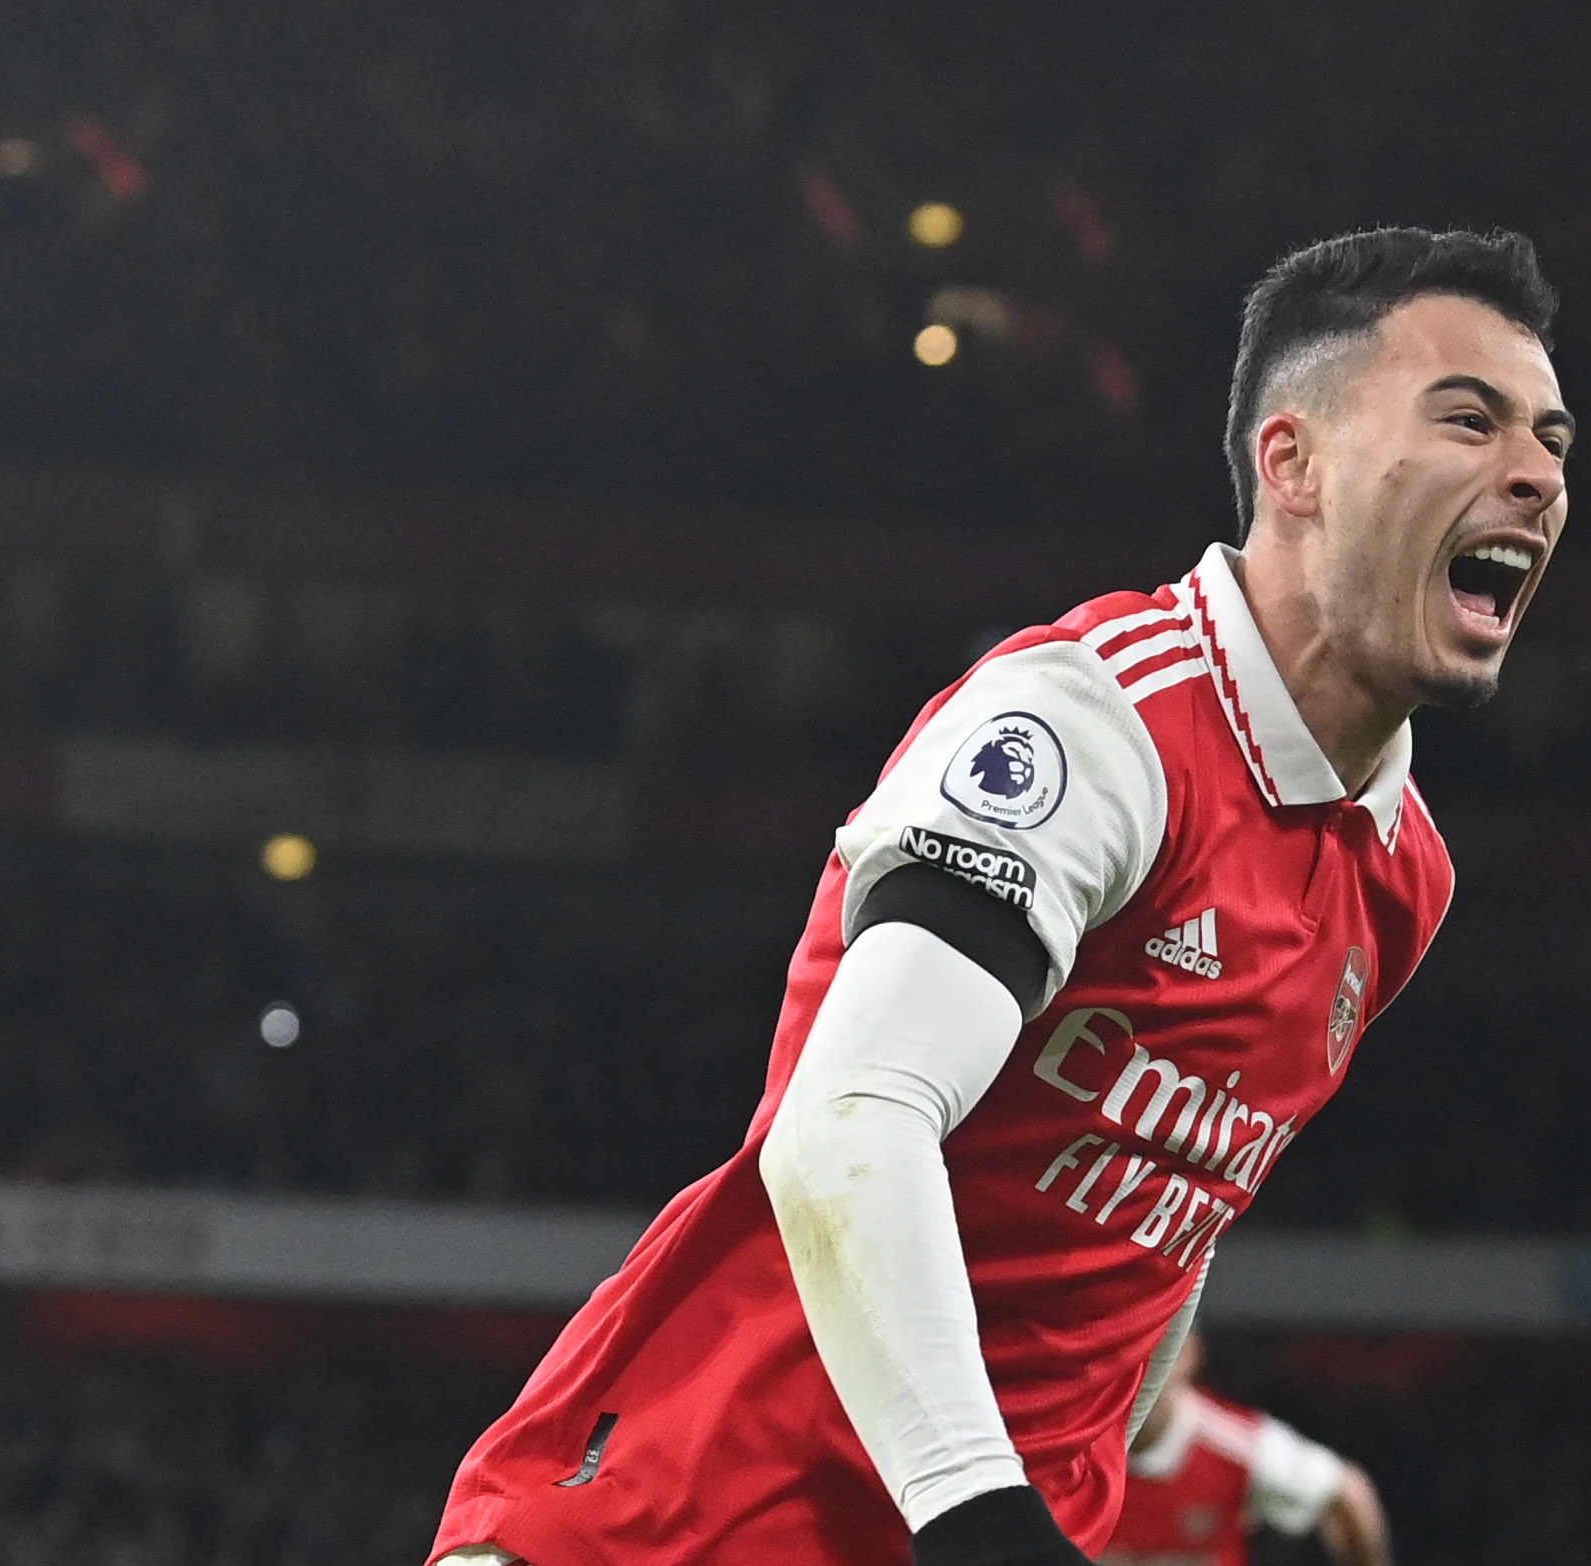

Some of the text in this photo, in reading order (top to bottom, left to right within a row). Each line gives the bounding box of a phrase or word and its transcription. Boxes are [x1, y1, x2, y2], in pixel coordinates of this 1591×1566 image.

[981, 786, 1048, 816] Premier League
[901, 827, 1025, 883] No room
[1145, 937, 1223, 980] adidas
[1034, 1133, 1157, 1225] FLY
